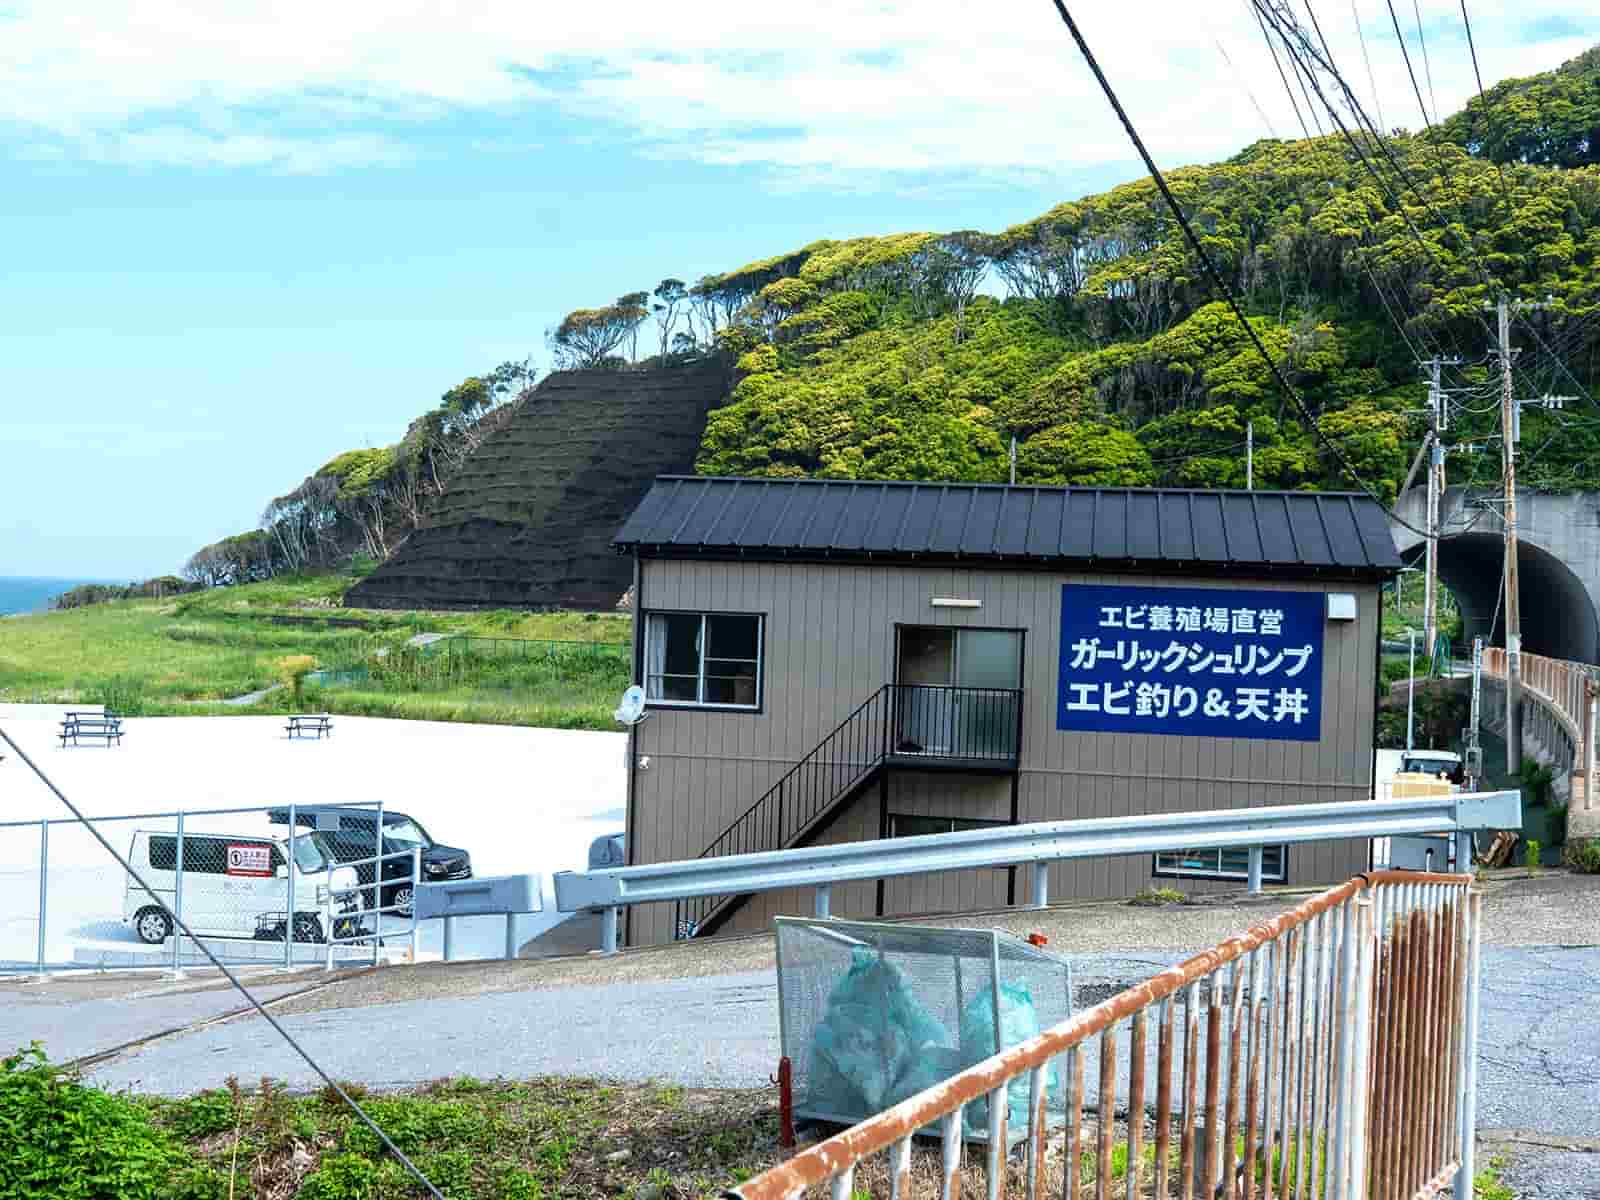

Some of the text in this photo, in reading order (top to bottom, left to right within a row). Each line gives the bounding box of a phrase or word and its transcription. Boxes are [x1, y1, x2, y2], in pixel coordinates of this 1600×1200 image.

[1099, 605, 1283, 635] エビ養殖場直営
[1070, 638, 1312, 677] ガーリックシュリンプ
